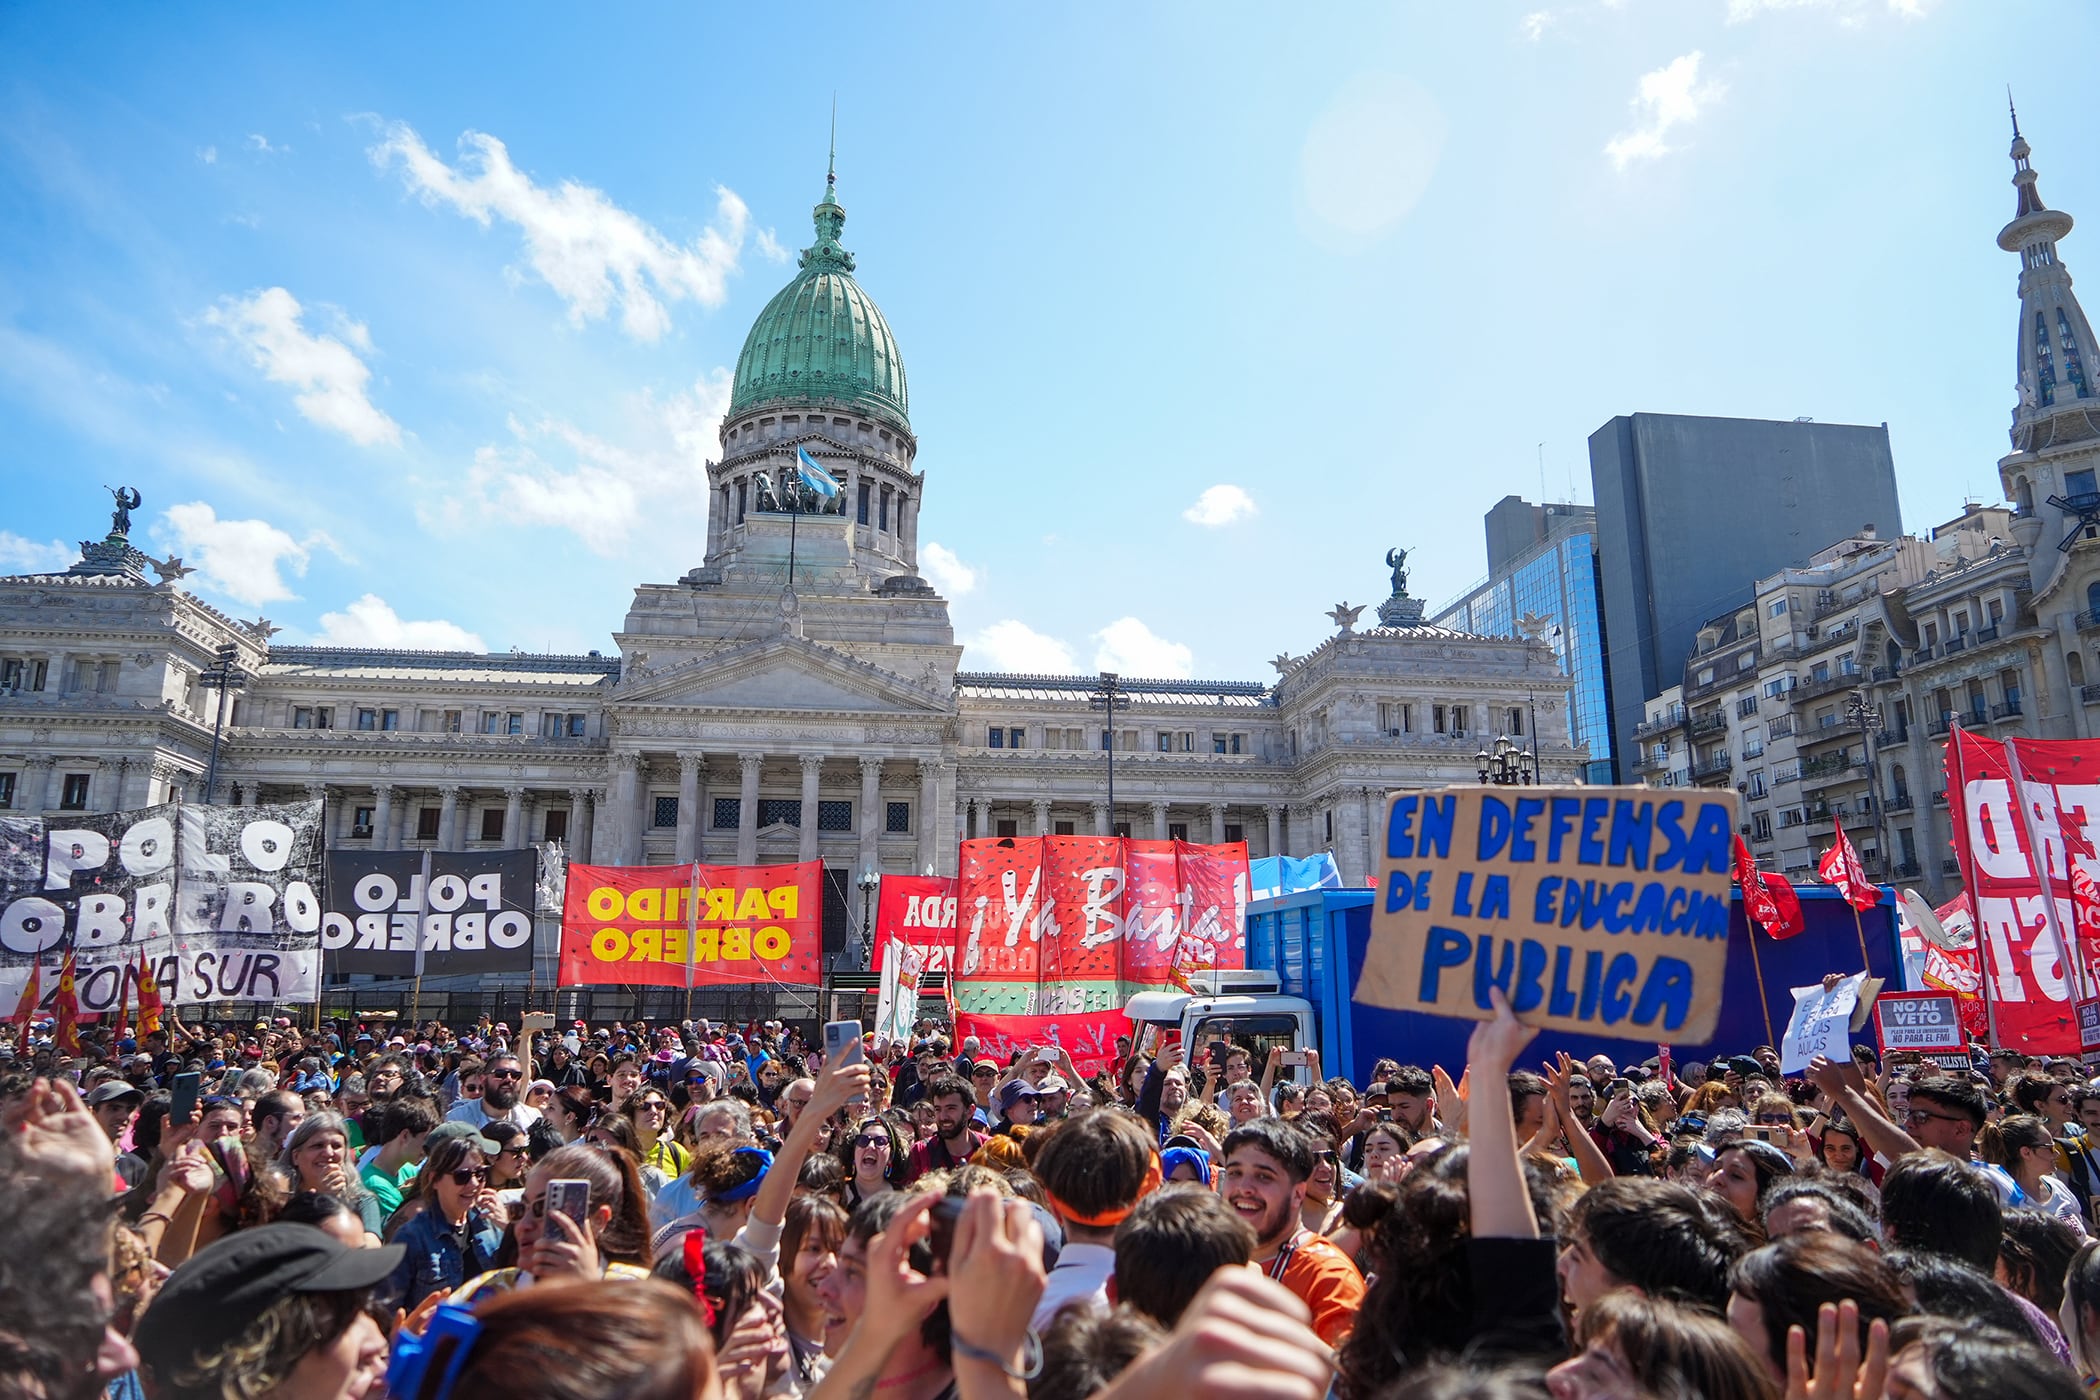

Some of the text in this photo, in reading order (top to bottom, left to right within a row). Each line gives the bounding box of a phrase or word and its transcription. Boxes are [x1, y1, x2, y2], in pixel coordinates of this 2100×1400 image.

[711, 726, 783, 739] CONGRESO
[1386, 794, 1731, 874] EN DEFENSA
[44, 817, 295, 891] POLO
[1386, 870, 1433, 914] DE
[1452, 871, 1511, 920] LA
[0, 881, 321, 953] OBRERO
[37, 952, 280, 1011] ZONA SUR
[1418, 925, 1694, 1032] PUBLICA
[1892, 1000, 1940, 1013] NO AL
[1894, 1011, 1942, 1025] VETO
[1812, 1020, 1831, 1036] LAS
[1892, 1033, 1950, 1043] NO PARA EL FMI
[1797, 1037, 1828, 1057] AULAS
